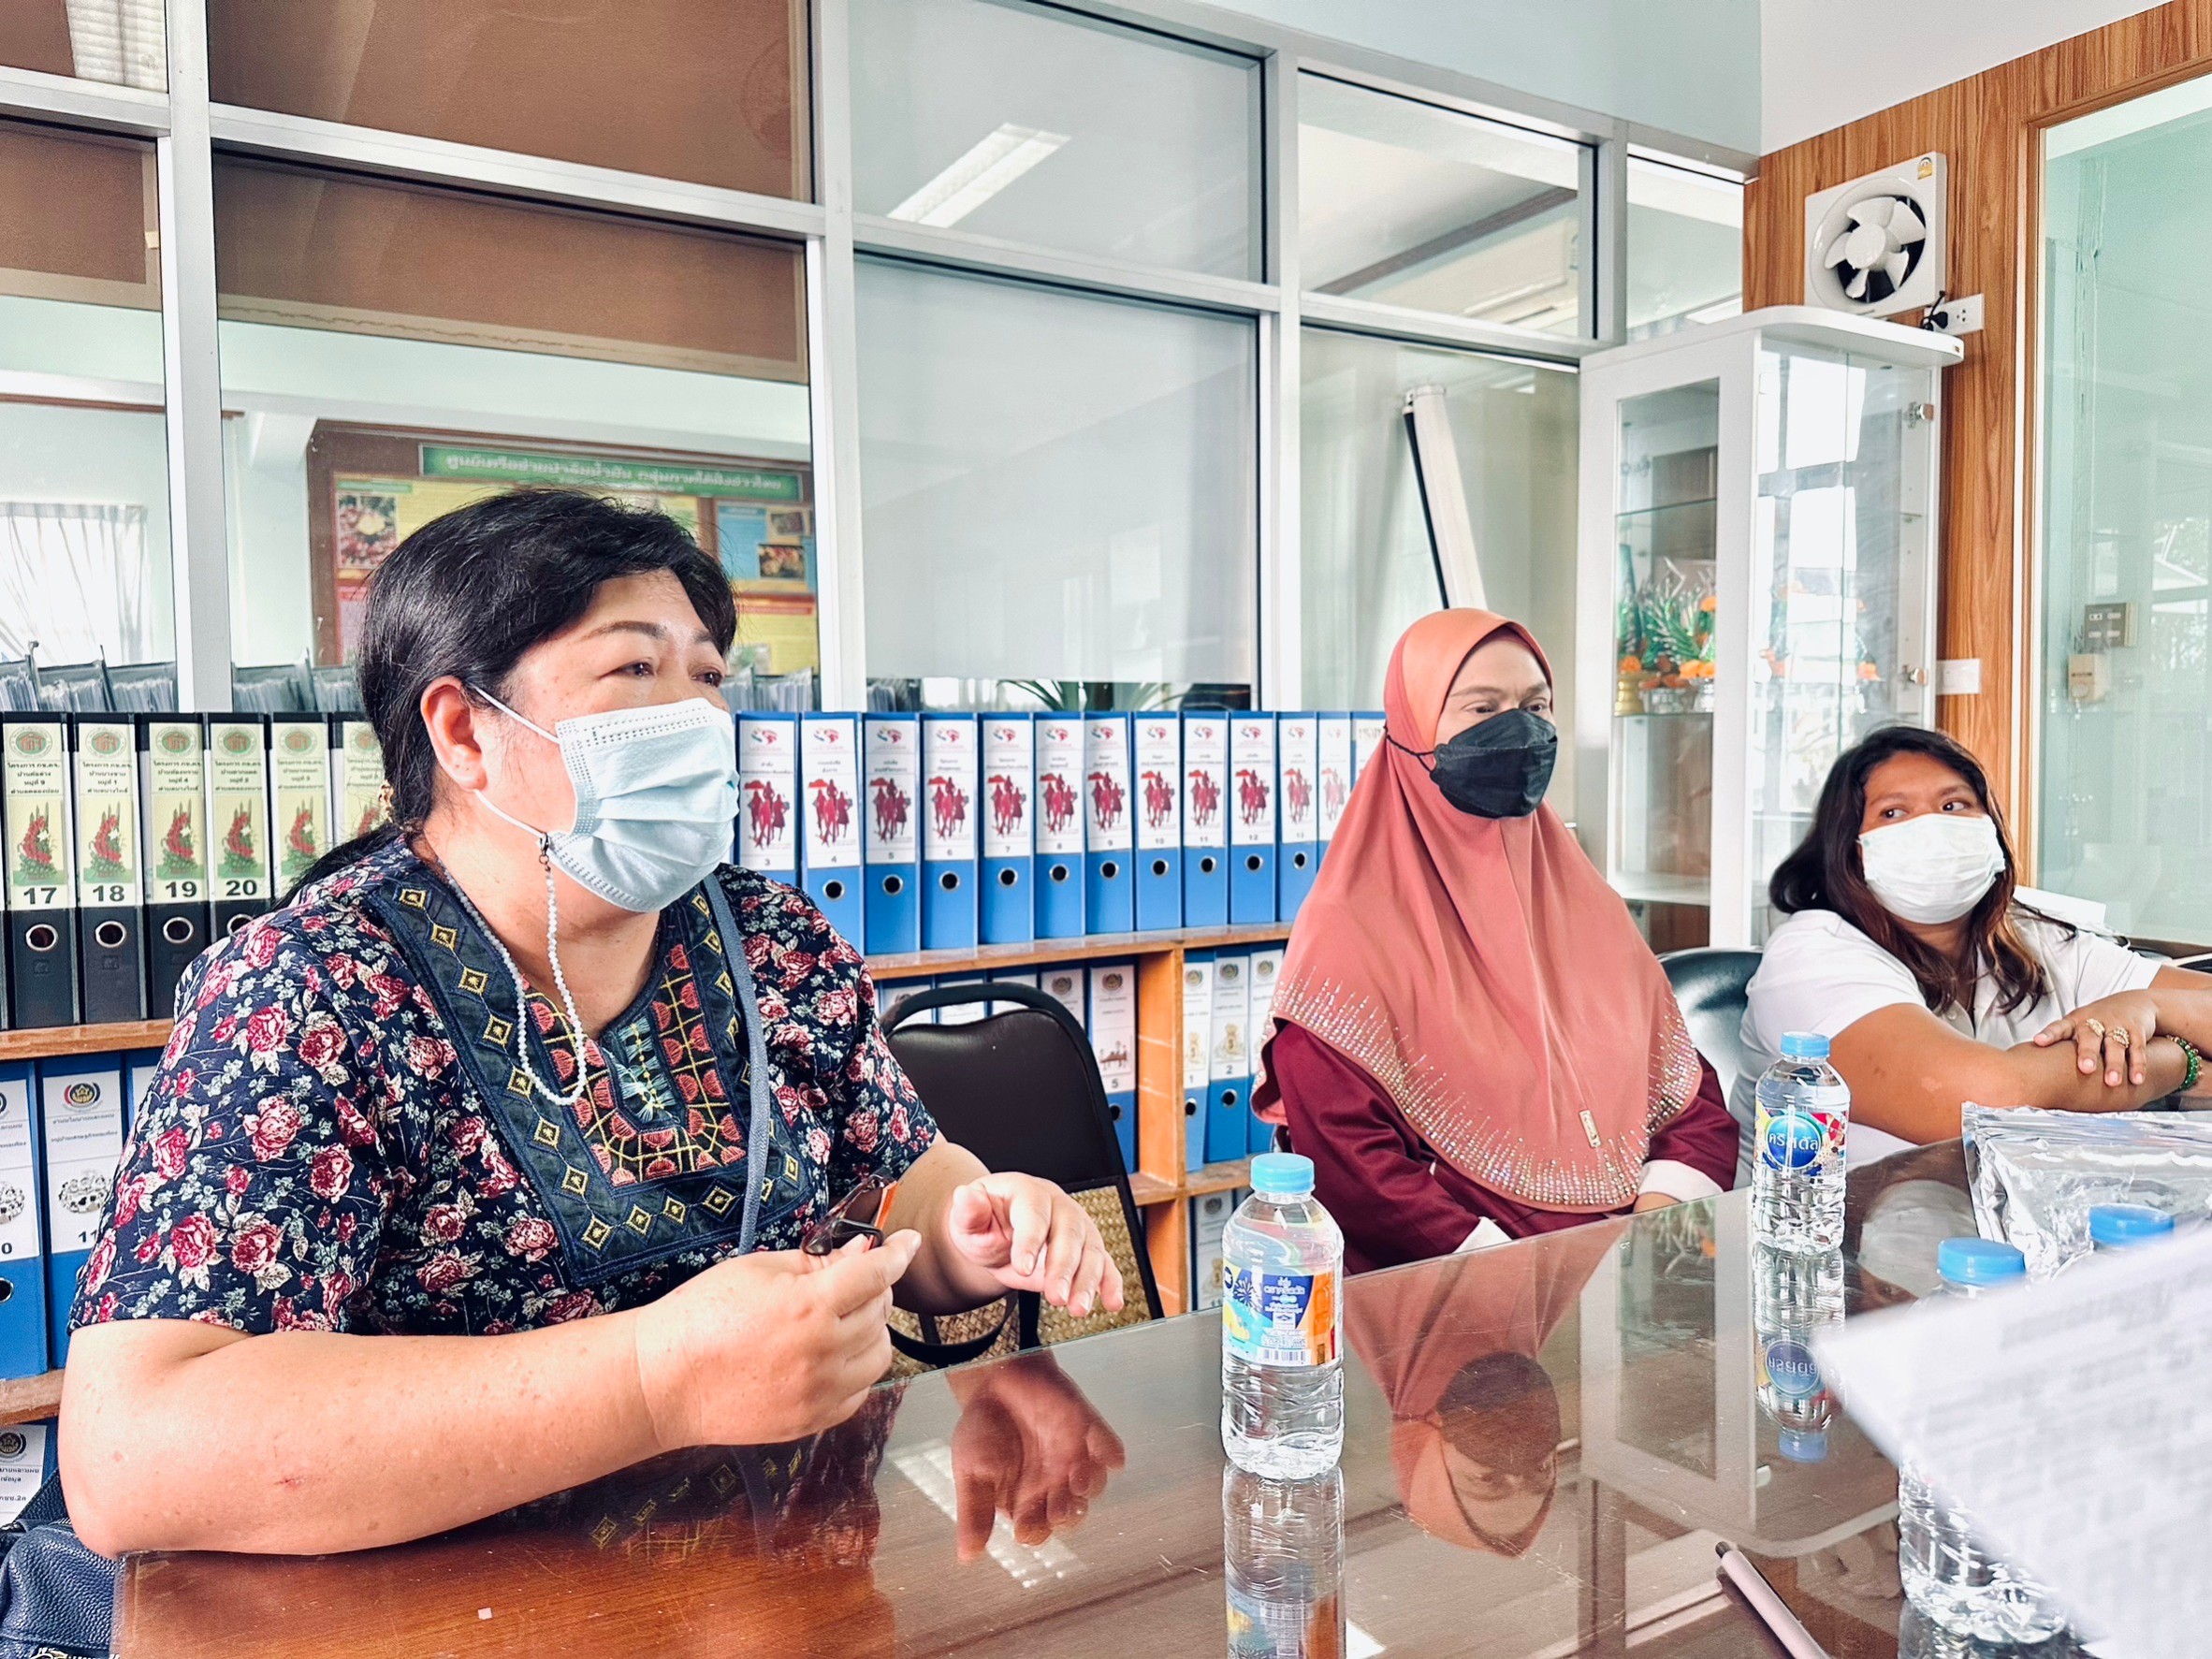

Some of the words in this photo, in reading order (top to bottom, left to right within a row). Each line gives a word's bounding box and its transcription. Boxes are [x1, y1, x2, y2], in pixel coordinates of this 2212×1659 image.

[1107, 838, 1113, 847] 9
[1004, 845, 1011, 853] 7
[764, 858, 771, 866] 3
[831, 855, 837, 864] 4
[165, 880, 197, 899] 19
[226, 879, 258, 897] 20
[22, 886, 58, 906] 17
[92, 884, 125, 903] 18
[1226, 1065, 1233, 1075] 2
[1111, 1077, 1119, 1088] 5
